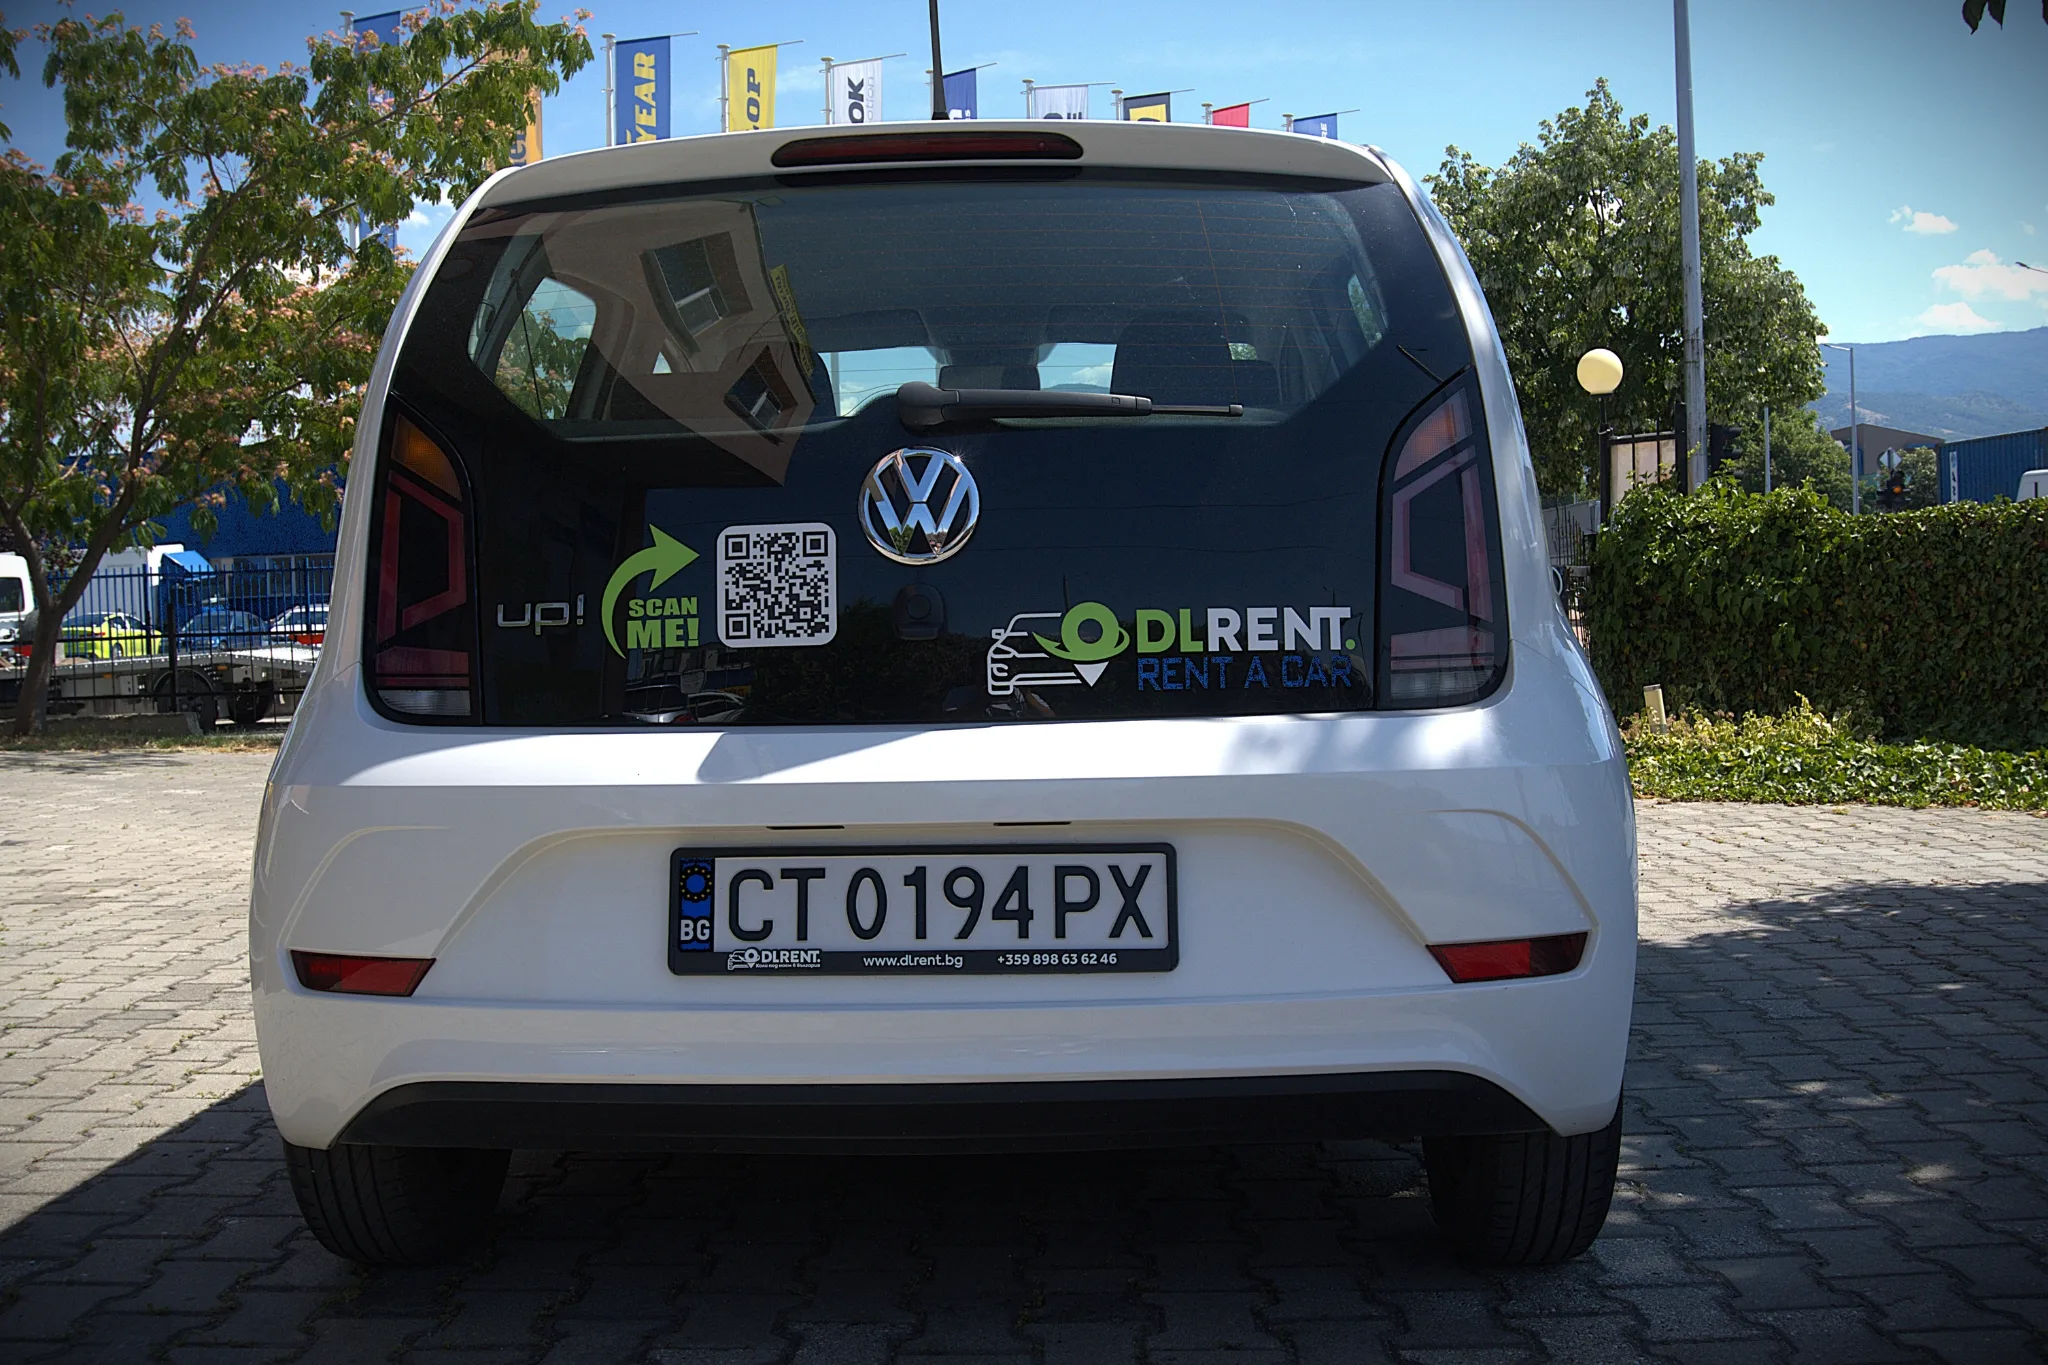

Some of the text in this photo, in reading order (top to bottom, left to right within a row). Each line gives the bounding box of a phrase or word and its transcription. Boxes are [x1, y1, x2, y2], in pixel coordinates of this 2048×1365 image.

[746, 67, 761, 131] OP
[497, 594, 585, 635] up!
[628, 596, 698, 617] SCAN
[627, 617, 699, 649] ME!
[1136, 655, 1353, 691] RENT A CAR
[728, 864, 1154, 942] CT 0194 PX
[680, 919, 710, 941] BG
[863, 954, 963, 968] www.dlrent.bg
[997, 953, 1117, 965] +359 898 63 62 46
